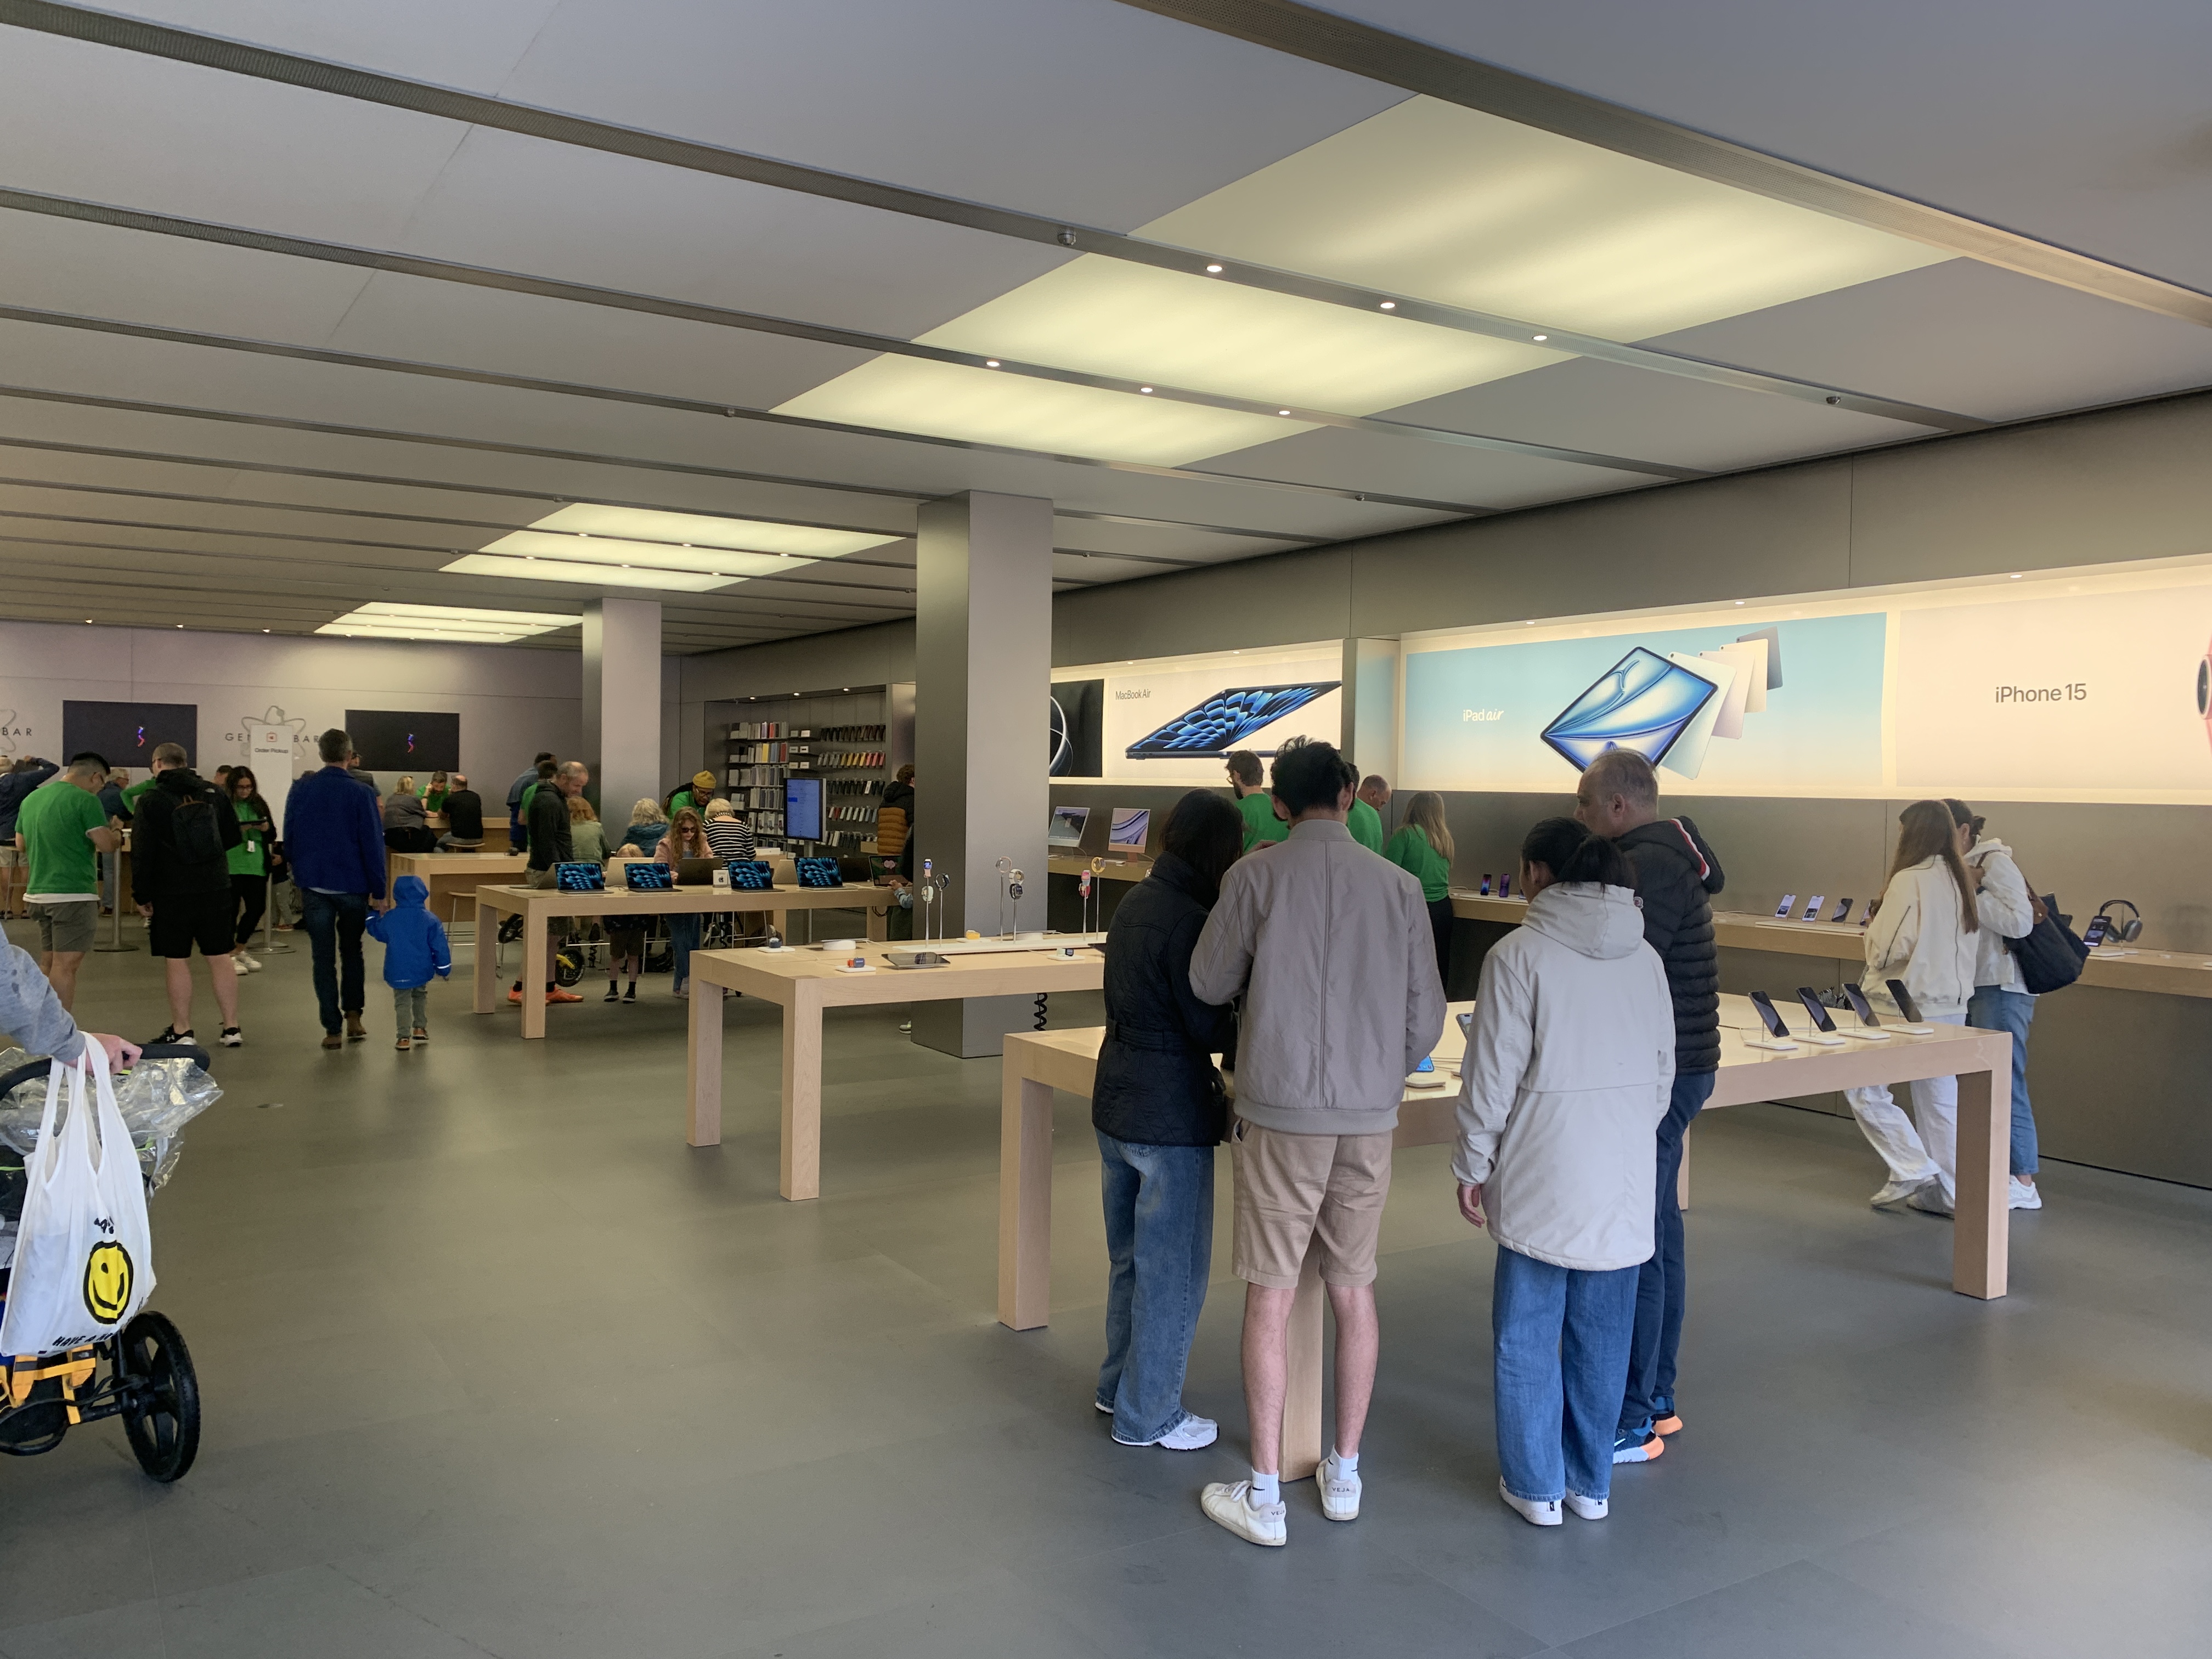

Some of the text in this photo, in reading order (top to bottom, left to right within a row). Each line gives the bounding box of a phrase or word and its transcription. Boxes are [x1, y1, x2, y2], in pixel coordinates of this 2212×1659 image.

[1115, 689, 1151, 700] MacBook Air
[1996, 683, 2087, 703] iPhone 15
[1463, 708, 1504, 721] iPad air
[2, 727, 32, 736] BAR
[294, 735, 319, 743] BAR
[52, 1336, 86, 1346] HAVE
